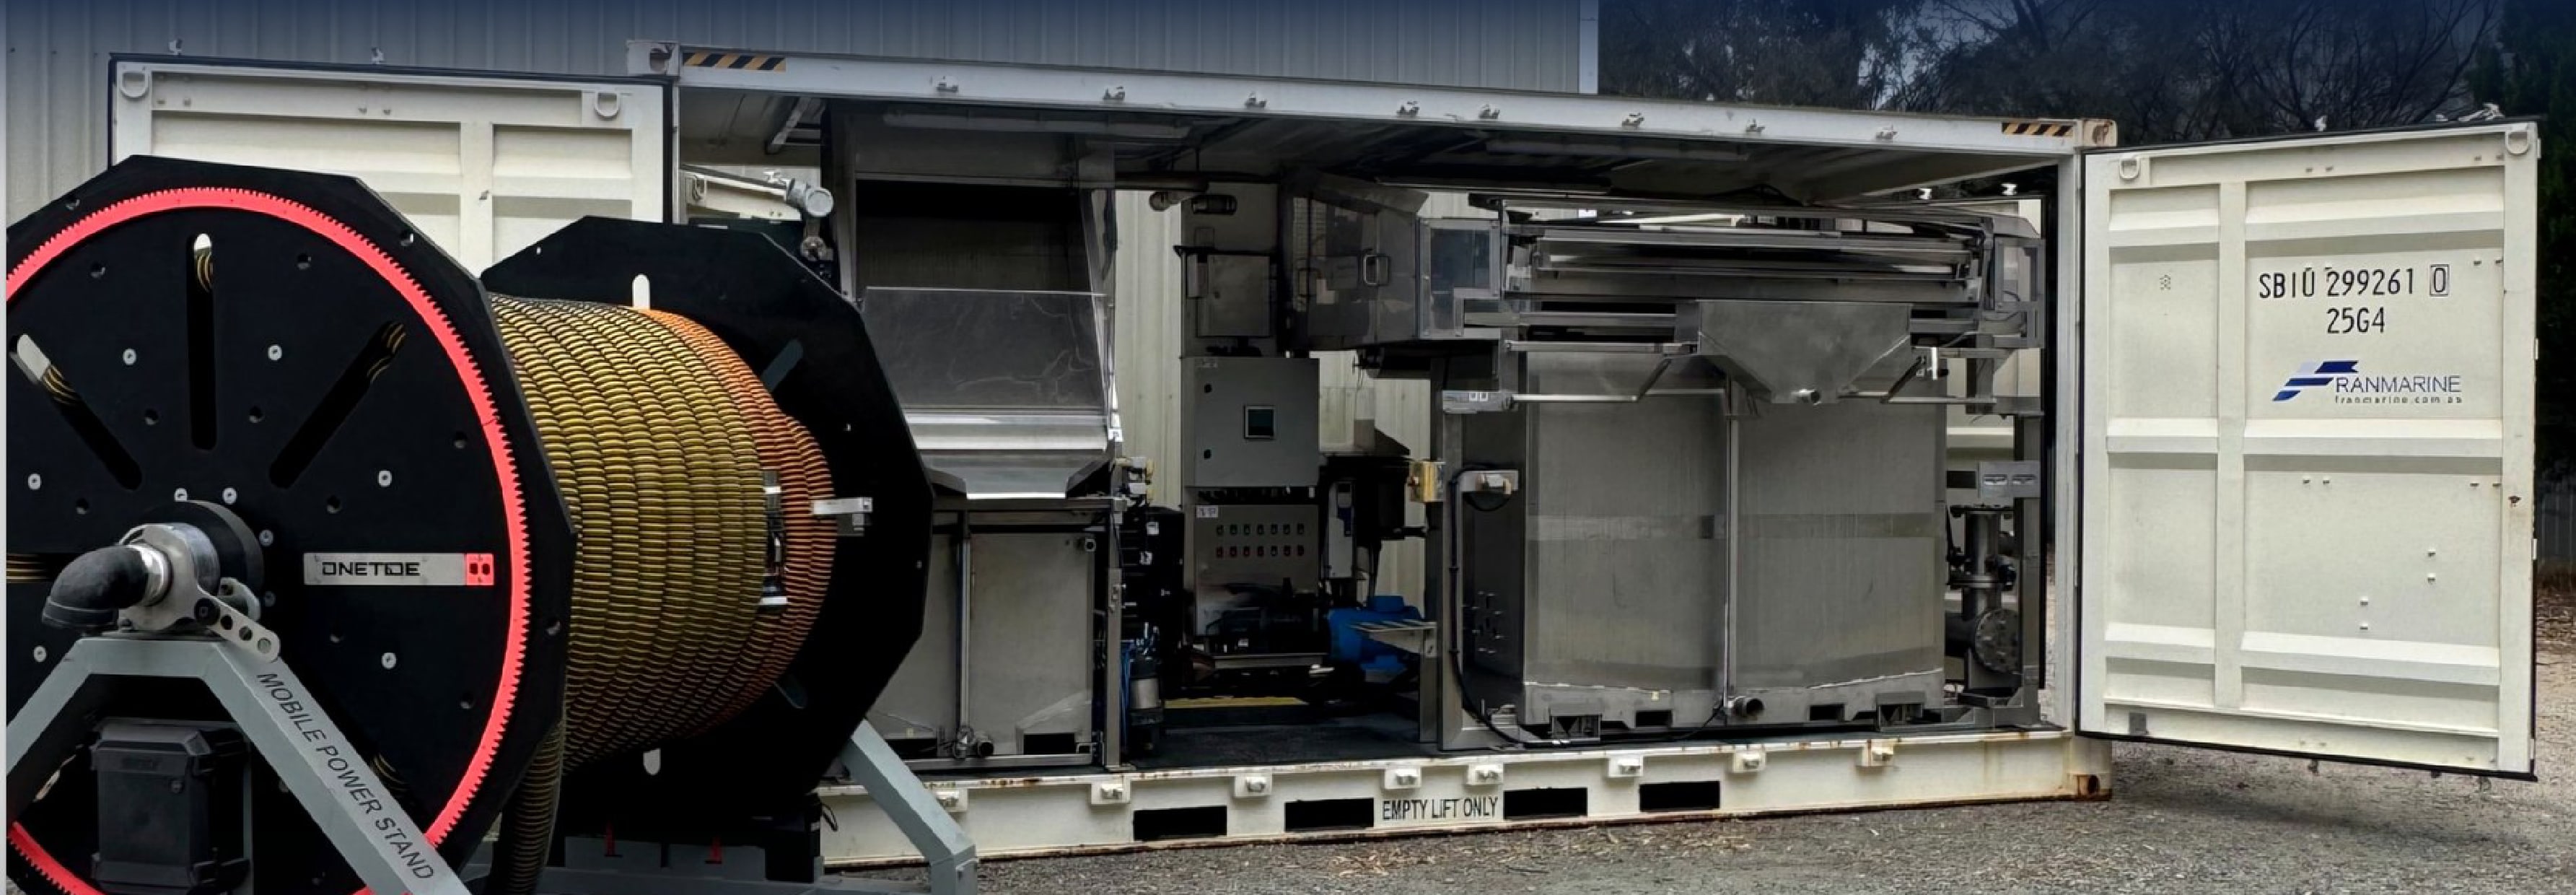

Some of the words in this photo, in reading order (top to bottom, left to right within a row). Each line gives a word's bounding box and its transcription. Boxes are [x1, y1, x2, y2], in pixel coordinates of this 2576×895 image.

[2259, 271, 2315, 299] SBIU
[2326, 268, 2414, 297] 299261
[2326, 307, 2386, 334] 25G4
[256, 673, 327, 743] MOBILE
[315, 745, 382, 814] POWER
[375, 817, 434, 879] STAND
[1383, 798, 1428, 821] EMPTY
[1432, 798, 1461, 818] LIFT
[1463, 796, 1499, 818] ONLY
